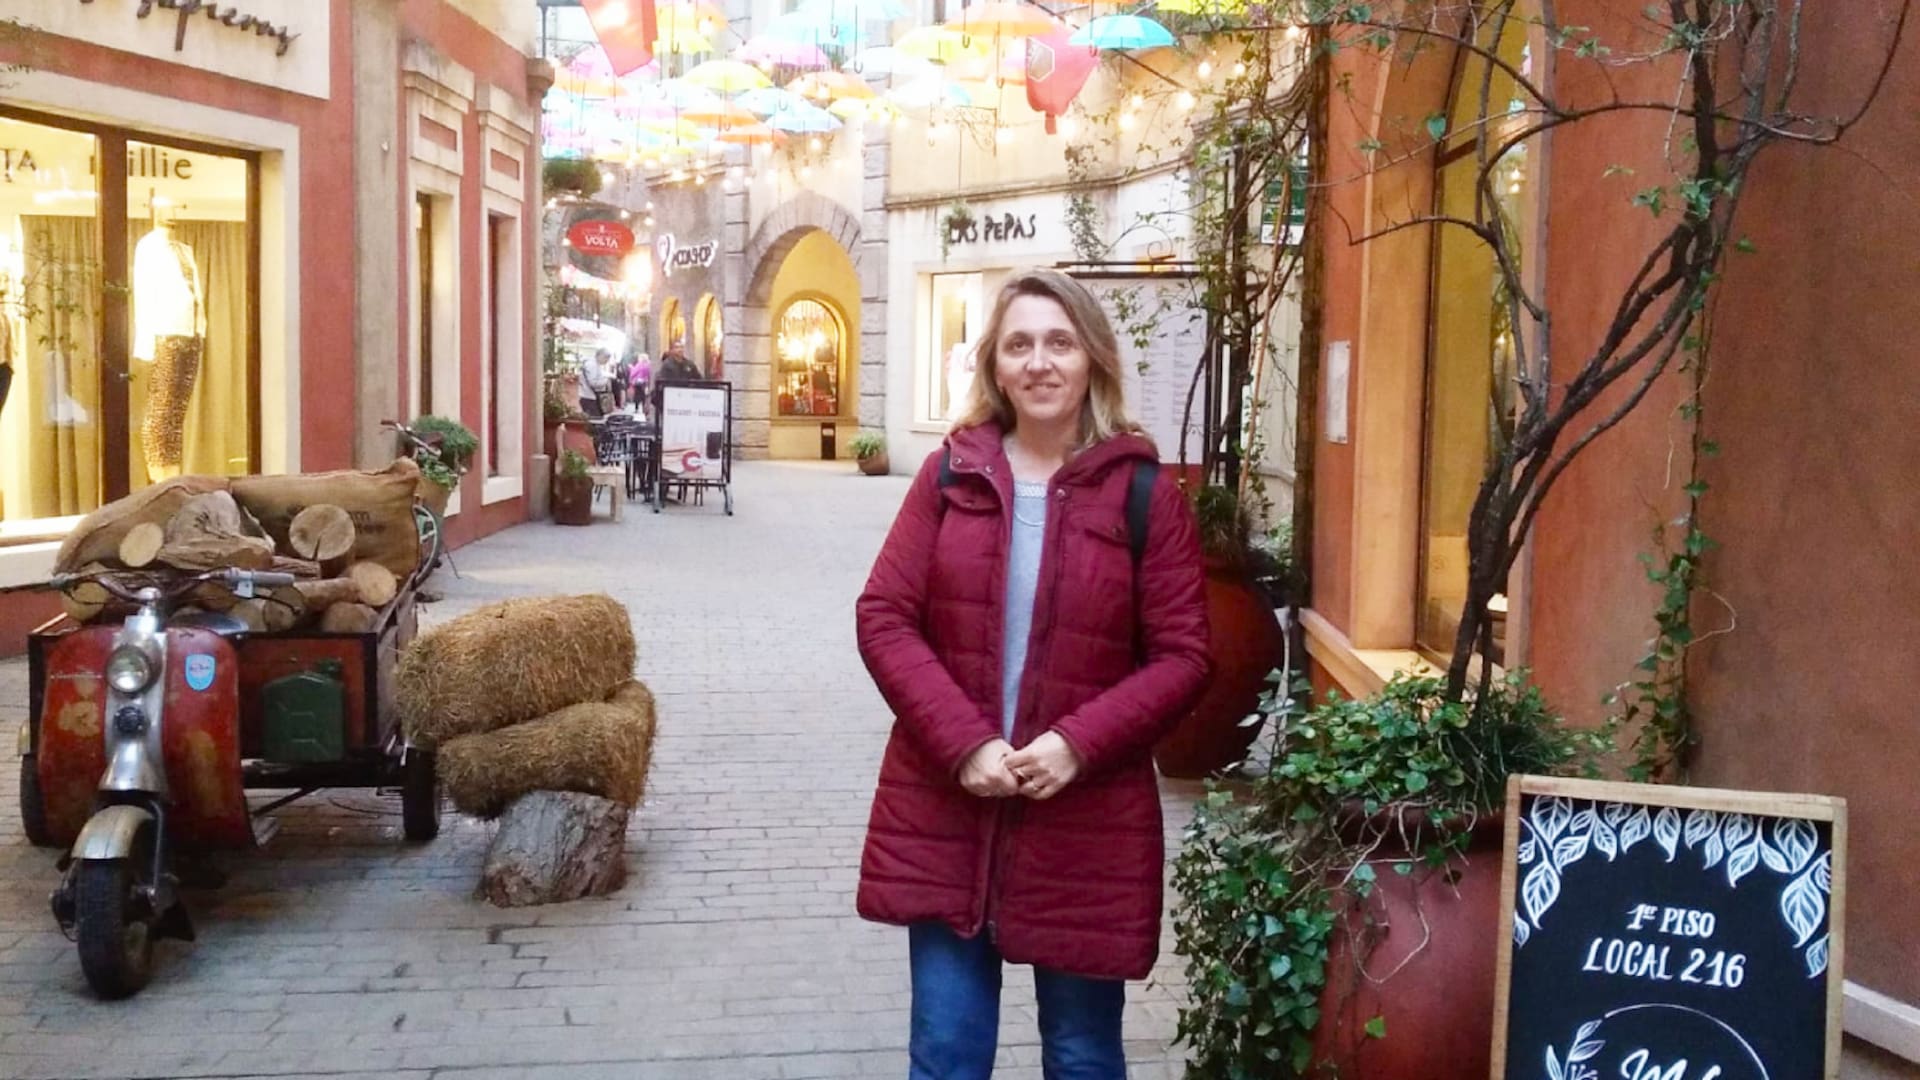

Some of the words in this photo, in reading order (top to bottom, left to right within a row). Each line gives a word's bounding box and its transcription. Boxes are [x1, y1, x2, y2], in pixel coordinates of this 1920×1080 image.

[89, 147, 192, 180] illie
[584, 233, 618, 249] VOLTA
[1658, 907, 1716, 938] PISO
[1583, 938, 1673, 979] LOCAL
[1680, 948, 1747, 988] 216
